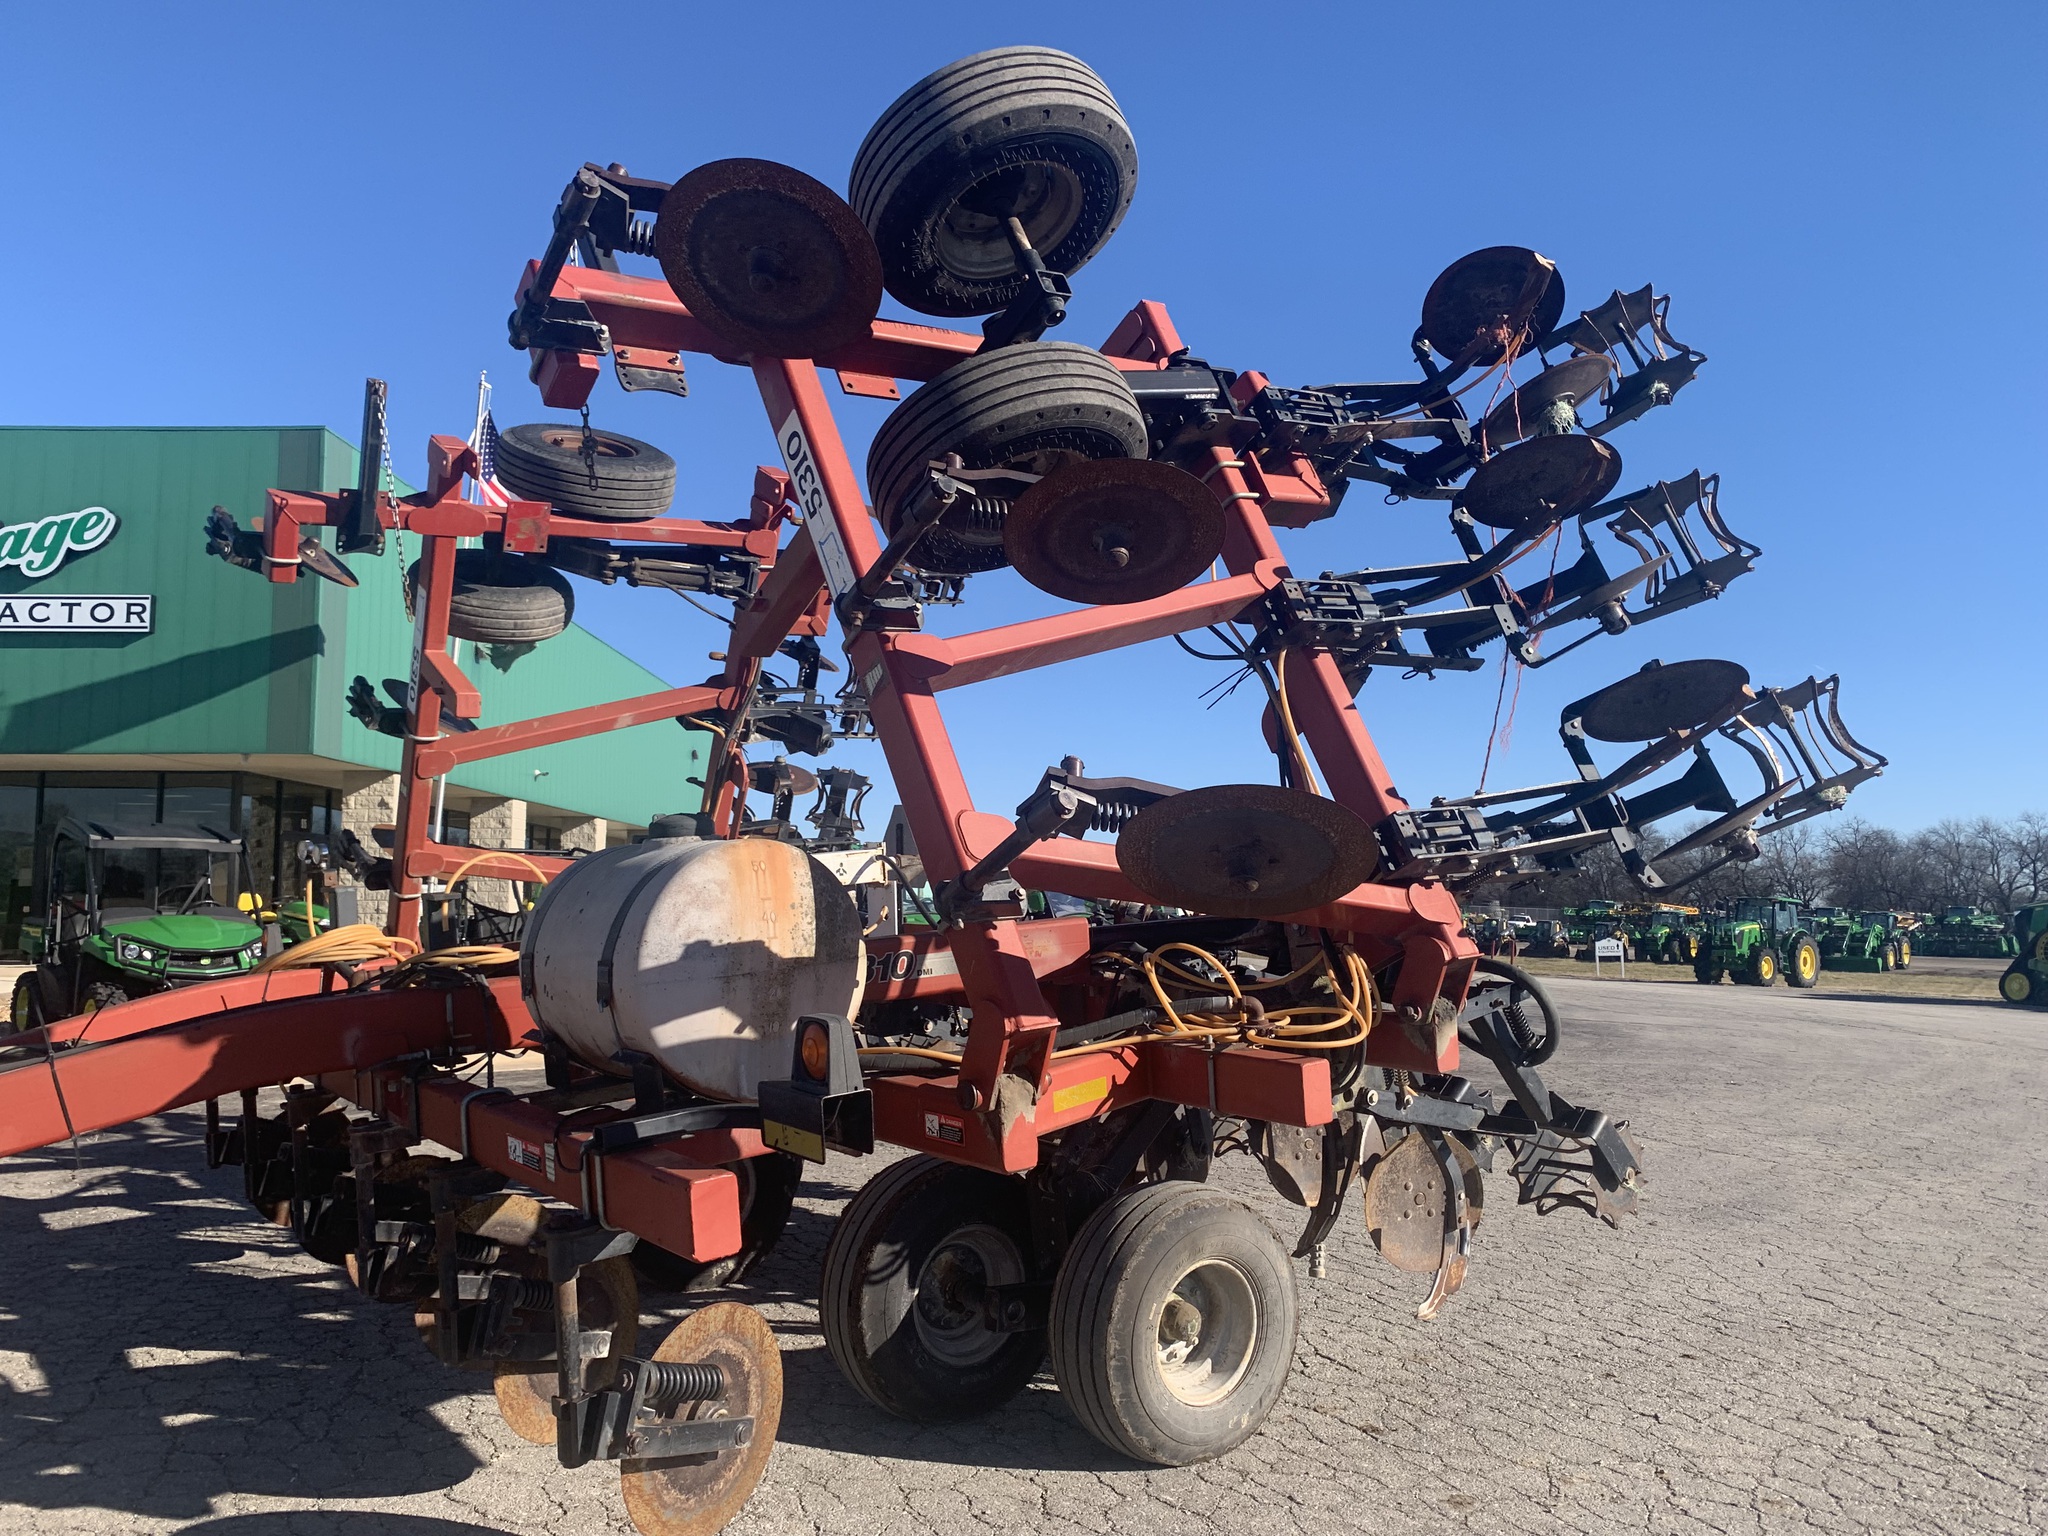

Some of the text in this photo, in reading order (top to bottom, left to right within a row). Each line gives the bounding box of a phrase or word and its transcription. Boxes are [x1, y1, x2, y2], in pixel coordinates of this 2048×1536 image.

[787, 430, 823, 519] 5310
[0, 511, 111, 571] age
[0, 602, 148, 623] ACTOR
[409, 646, 420, 702] 5310
[751, 860, 766, 872] 50
[762, 911, 776, 923] 40
[917, 968, 933, 976] DMI
